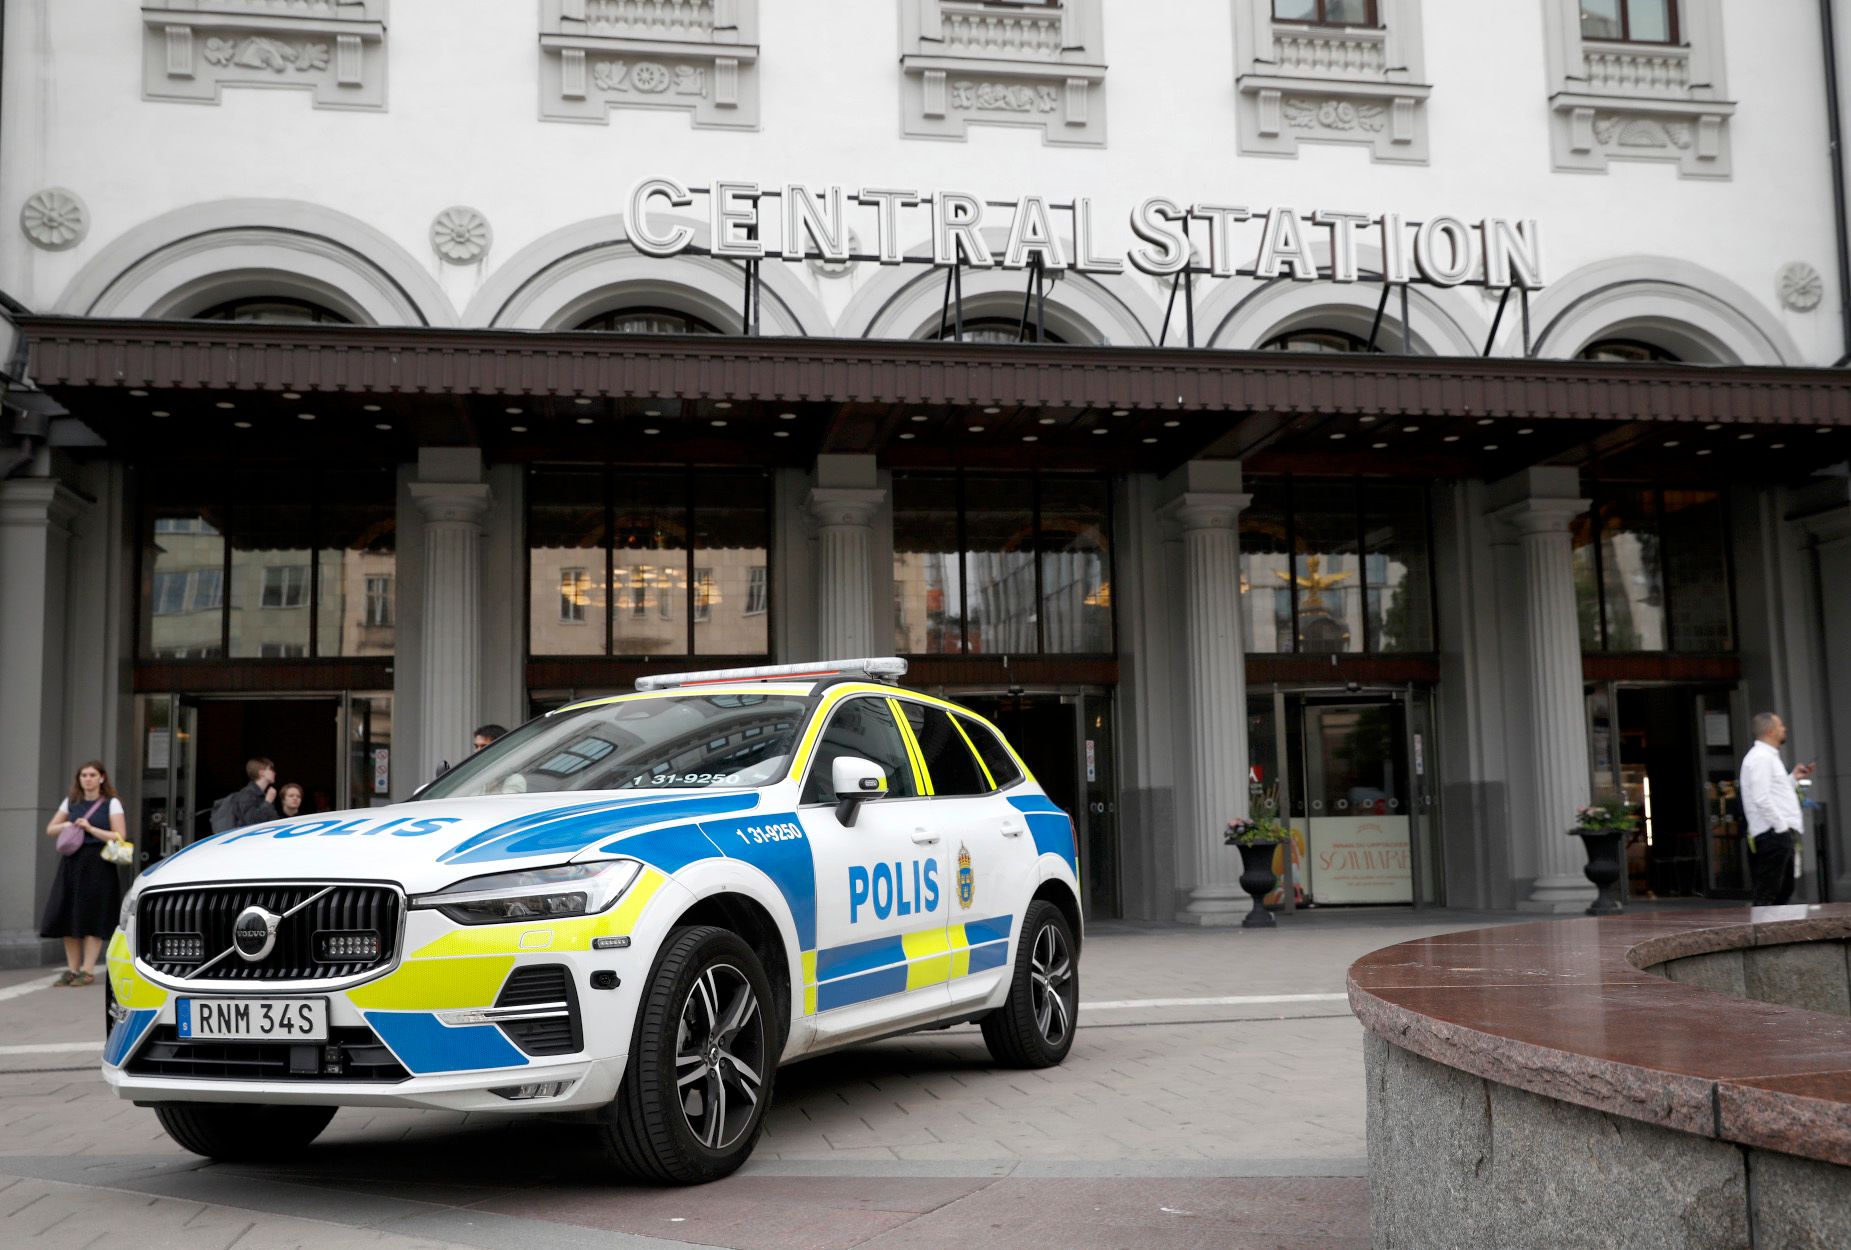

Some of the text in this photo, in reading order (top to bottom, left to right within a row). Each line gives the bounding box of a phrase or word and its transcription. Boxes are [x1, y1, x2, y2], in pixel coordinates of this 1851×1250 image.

[623, 175, 1546, 290] CENTRALSTATION
[633, 773, 740, 786] 1 31-9250
[219, 817, 463, 844] POLIS
[736, 822, 803, 845] 1 31-9250
[848, 858, 940, 924] POLIS
[182, 1022, 188, 1031] S
[199, 1003, 314, 1034] RNM 34S
